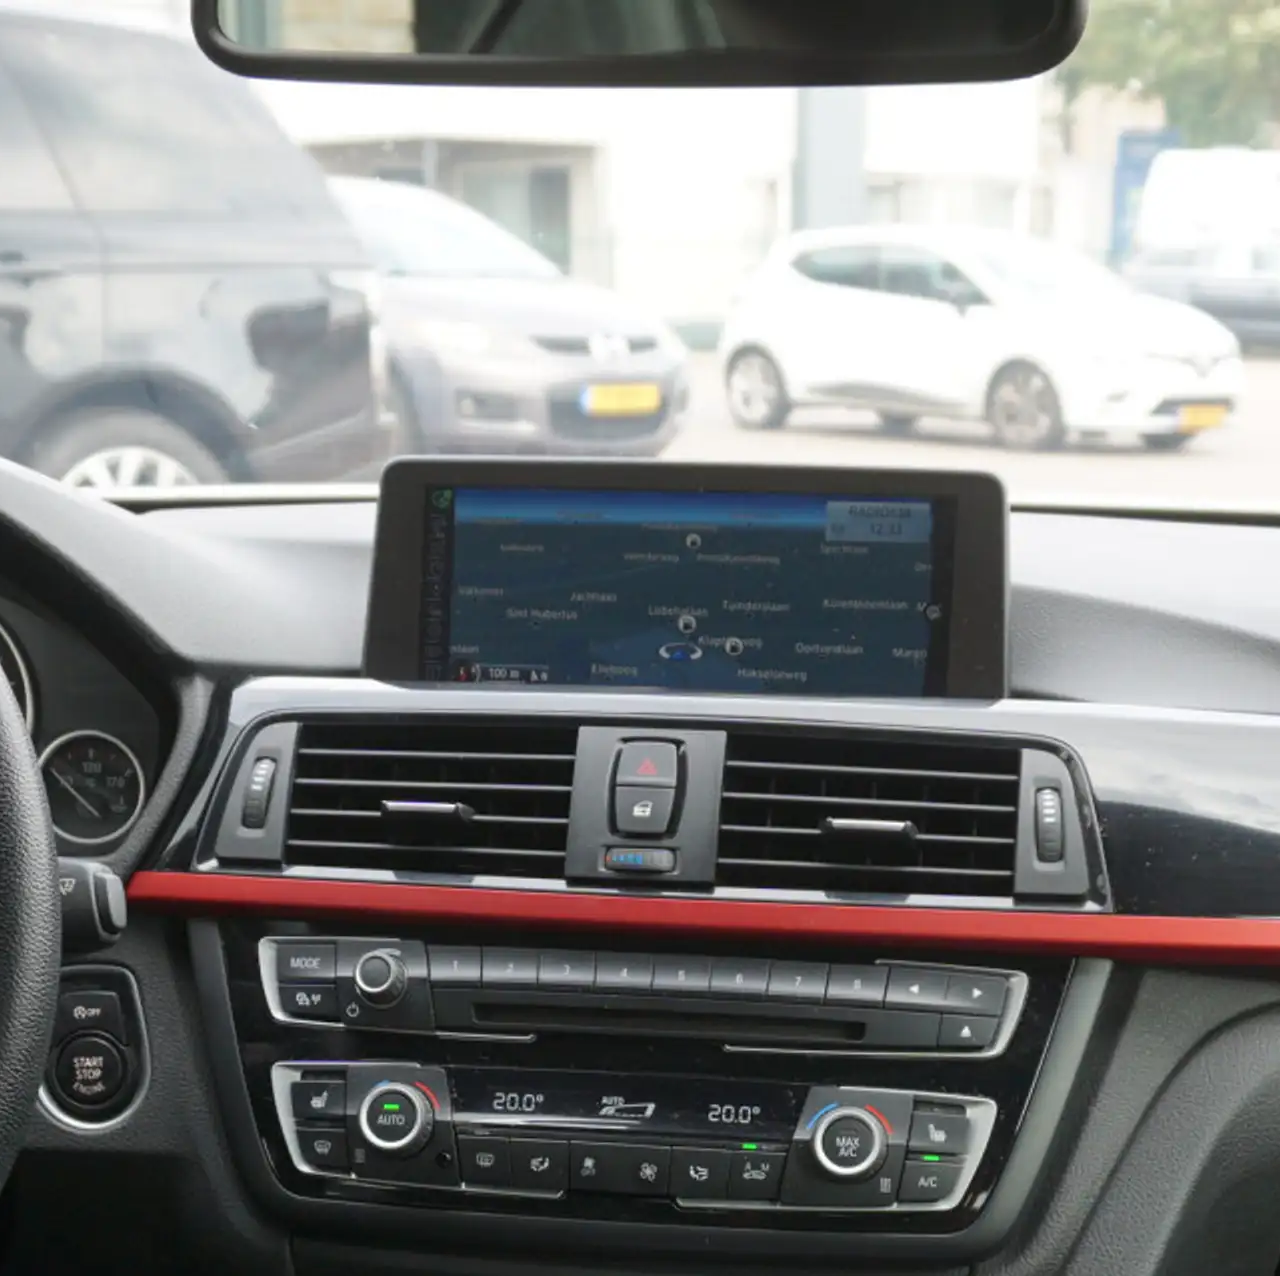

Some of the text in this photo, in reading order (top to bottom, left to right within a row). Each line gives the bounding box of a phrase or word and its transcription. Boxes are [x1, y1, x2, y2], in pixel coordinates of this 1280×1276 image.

[488, 668, 508, 679] 100
[290, 956, 321, 969] MODE
[73, 1055, 104, 1068] START
[76, 1068, 102, 1080] STOP
[376, 1114, 405, 1126] AUTO
[835, 1136, 860, 1147] MAX
[838, 1148, 857, 1157] A/C
[918, 1176, 938, 1188] A/C
